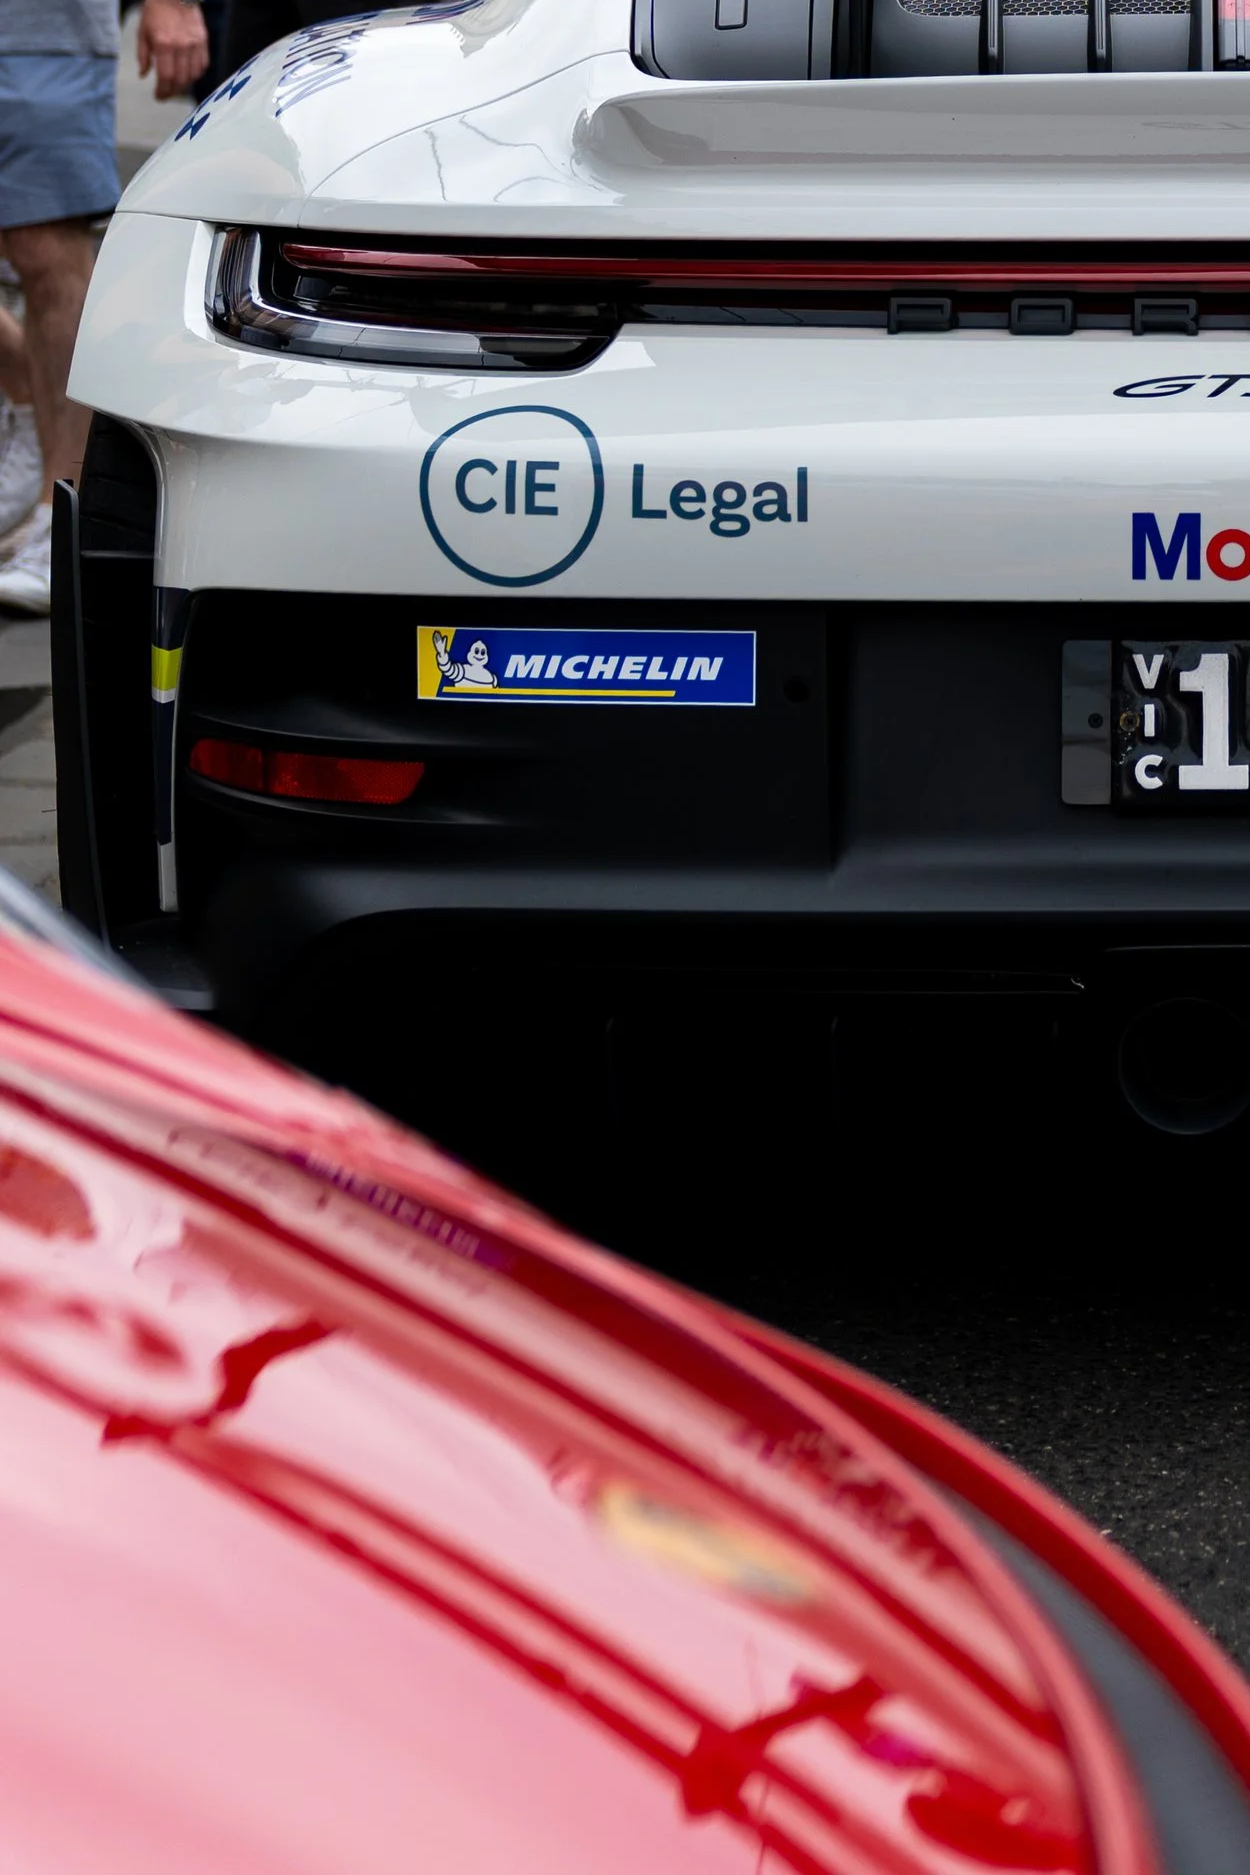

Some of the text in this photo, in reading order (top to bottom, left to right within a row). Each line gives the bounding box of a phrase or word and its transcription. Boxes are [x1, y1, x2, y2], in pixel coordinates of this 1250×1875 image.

[454, 458, 809, 538] CIE Legal
[503, 654, 724, 681] MICHELIN
[1132, 653, 1165, 790] VIC
